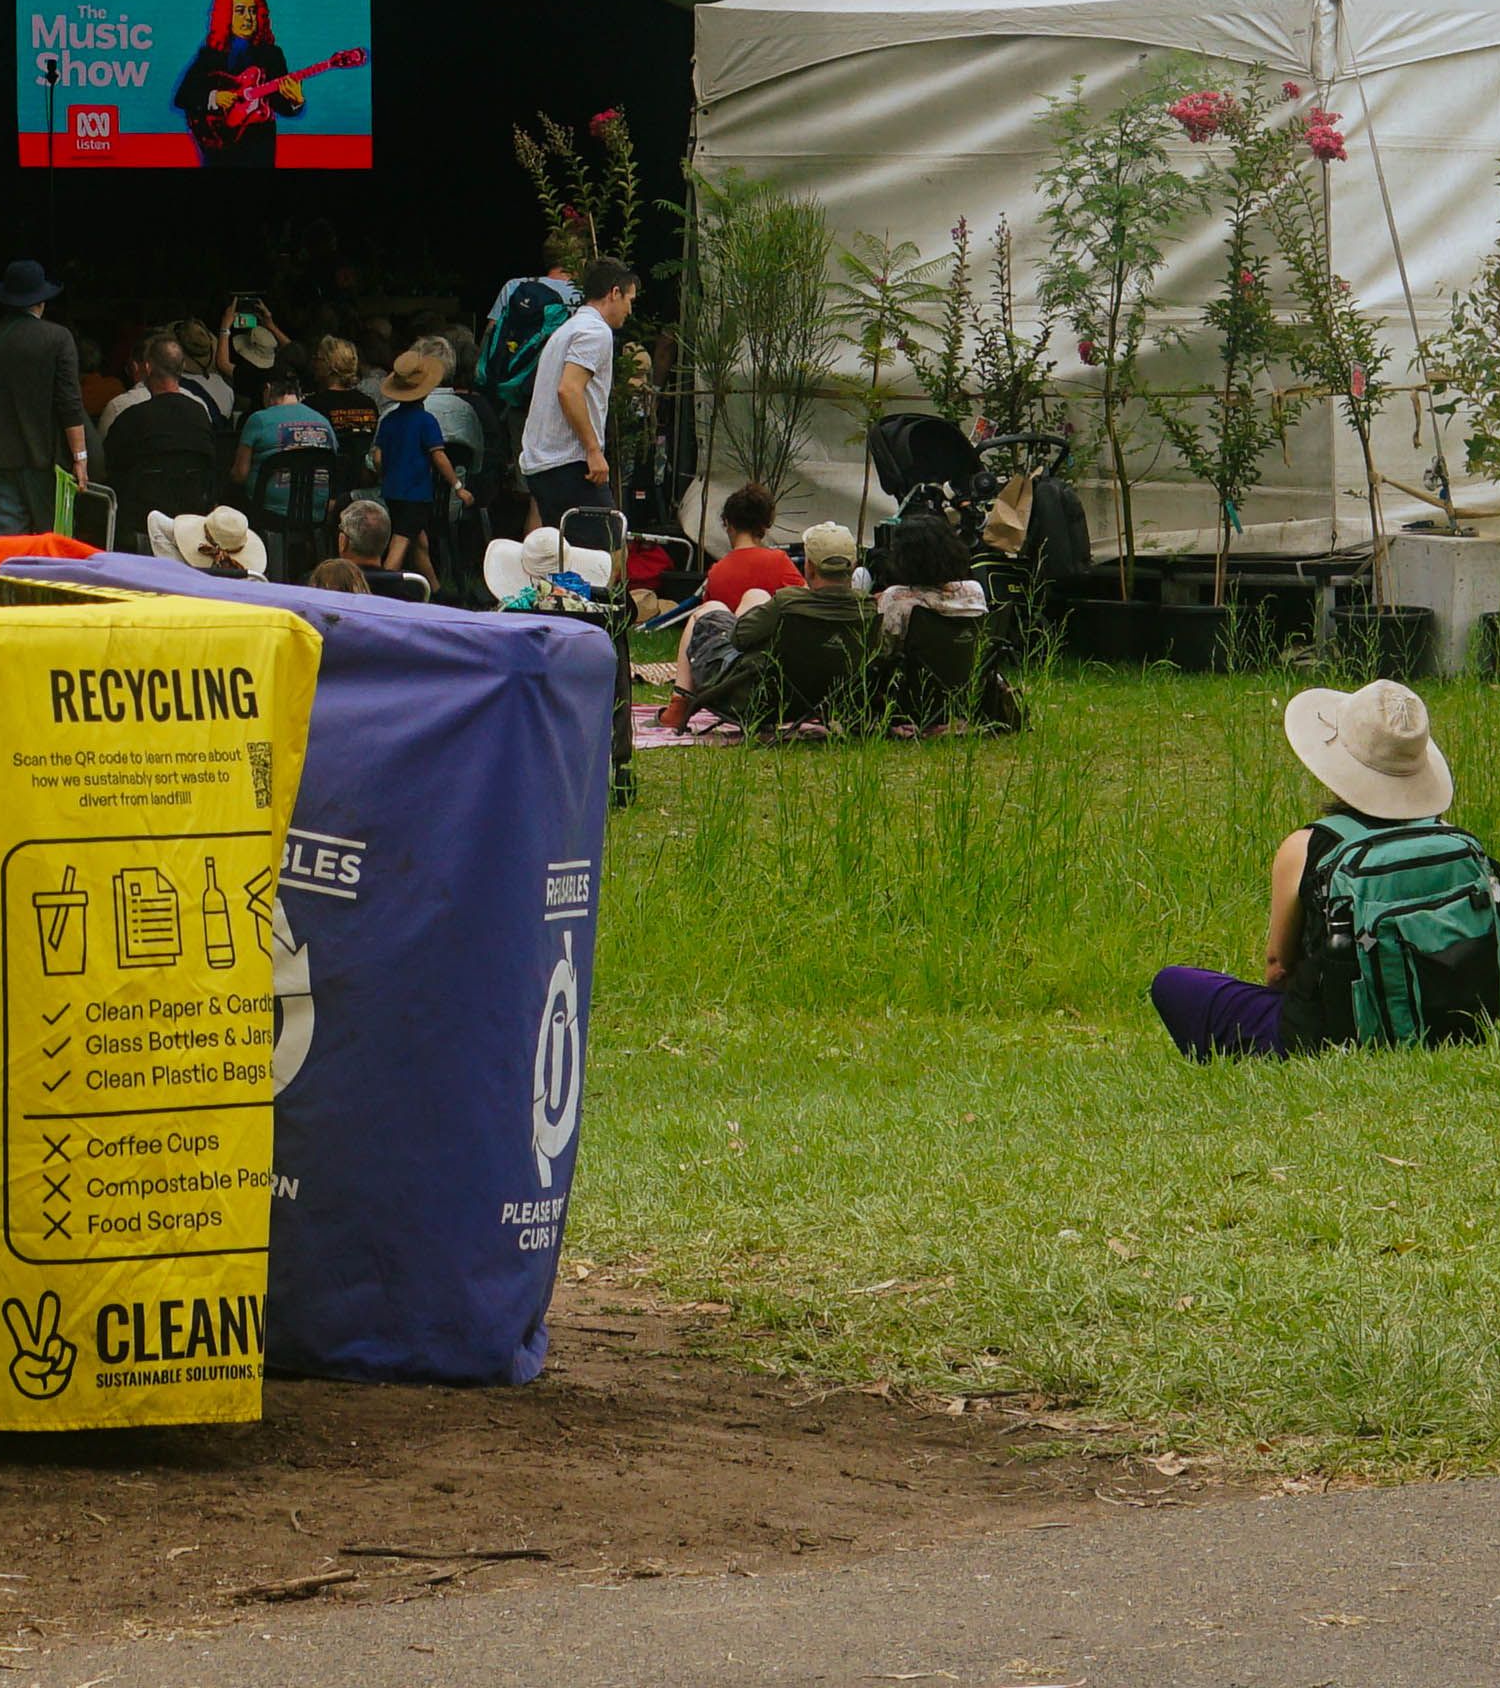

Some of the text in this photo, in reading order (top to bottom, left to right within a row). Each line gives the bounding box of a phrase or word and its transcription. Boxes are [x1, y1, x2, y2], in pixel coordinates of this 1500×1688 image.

[77, 5, 106, 19] The
[32, 14, 152, 50] Music
[36, 50, 149, 87] Show
[77, 139, 110, 150] listen
[50, 667, 259, 723] RECYCLING
[86, 1002, 143, 1022] Clean
[149, 999, 203, 1021] Paper
[209, 996, 222, 1015] &
[86, 1025, 273, 1055] Glass Bottles & Jars
[86, 1061, 265, 1090] Clean Plastic Bags
[87, 1133, 220, 1158] Coffee Cups
[87, 1171, 232, 1200] Compostable
[88, 1210, 222, 1234] Food Scraps
[97, 1294, 266, 1364] CLEANV
[96, 1364, 256, 1388] SUSTAINABLE SOLUTIONS,
